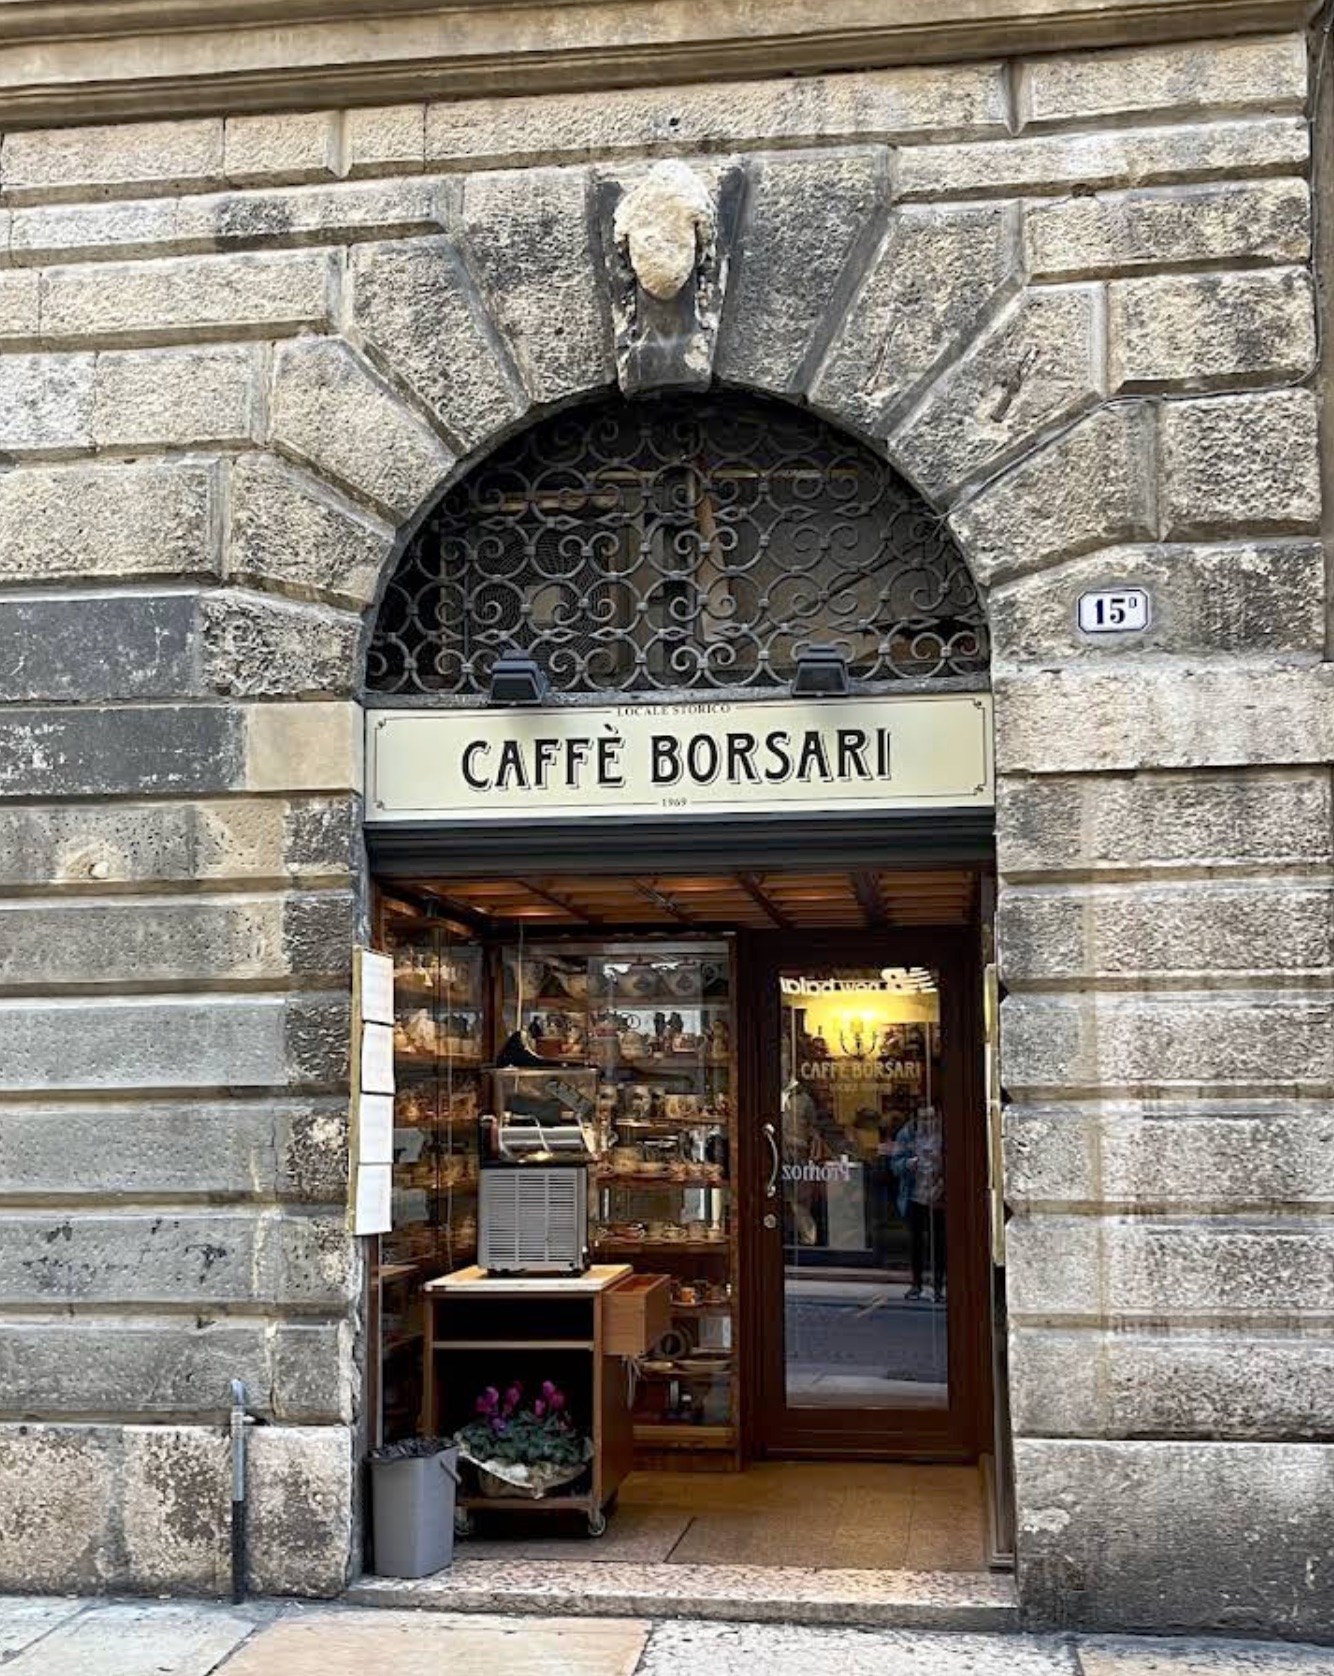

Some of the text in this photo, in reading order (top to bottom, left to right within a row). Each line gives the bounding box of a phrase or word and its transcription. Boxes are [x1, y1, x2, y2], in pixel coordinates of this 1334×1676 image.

[617, 703, 731, 717] LOCALE STORICO
[461, 723, 892, 791] CAFFÈ BORSARI
[662, 797, 687, 807] 1969
[851, 1060, 921, 1079] BORSARI
